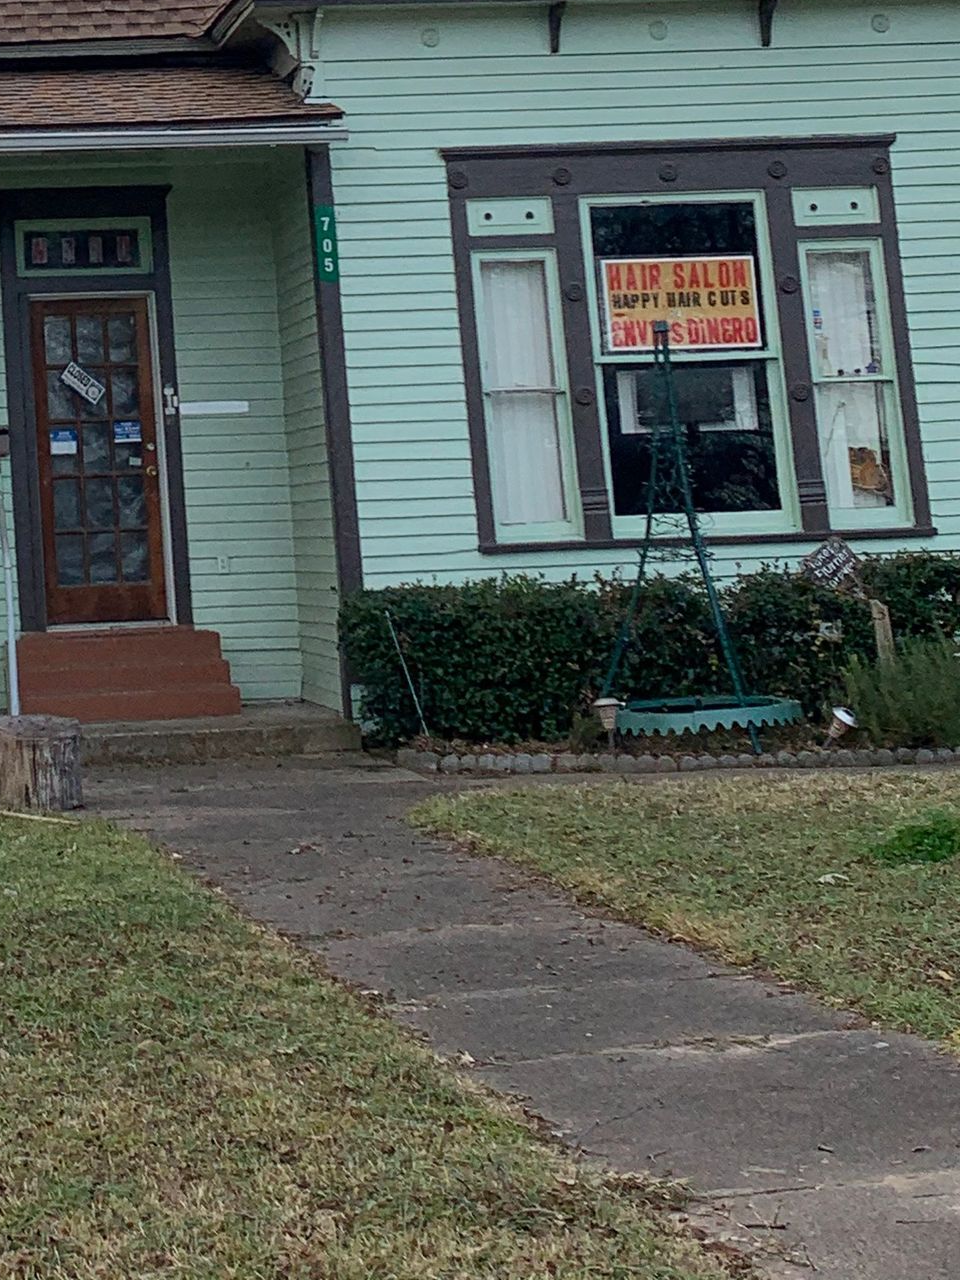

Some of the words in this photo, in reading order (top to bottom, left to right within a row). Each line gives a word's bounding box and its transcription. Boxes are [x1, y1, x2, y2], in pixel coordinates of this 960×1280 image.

[320, 216, 334, 272] 705
[607, 263, 662, 291] HAIR
[672, 260, 746, 289] SALON
[612, 292, 659, 309] HAPPY
[665, 291, 701, 308] HAIR
[707, 290, 750, 307] CUTS
[611, 319, 684, 347] ENVS
[67, 364, 91, 387] CLOSED
